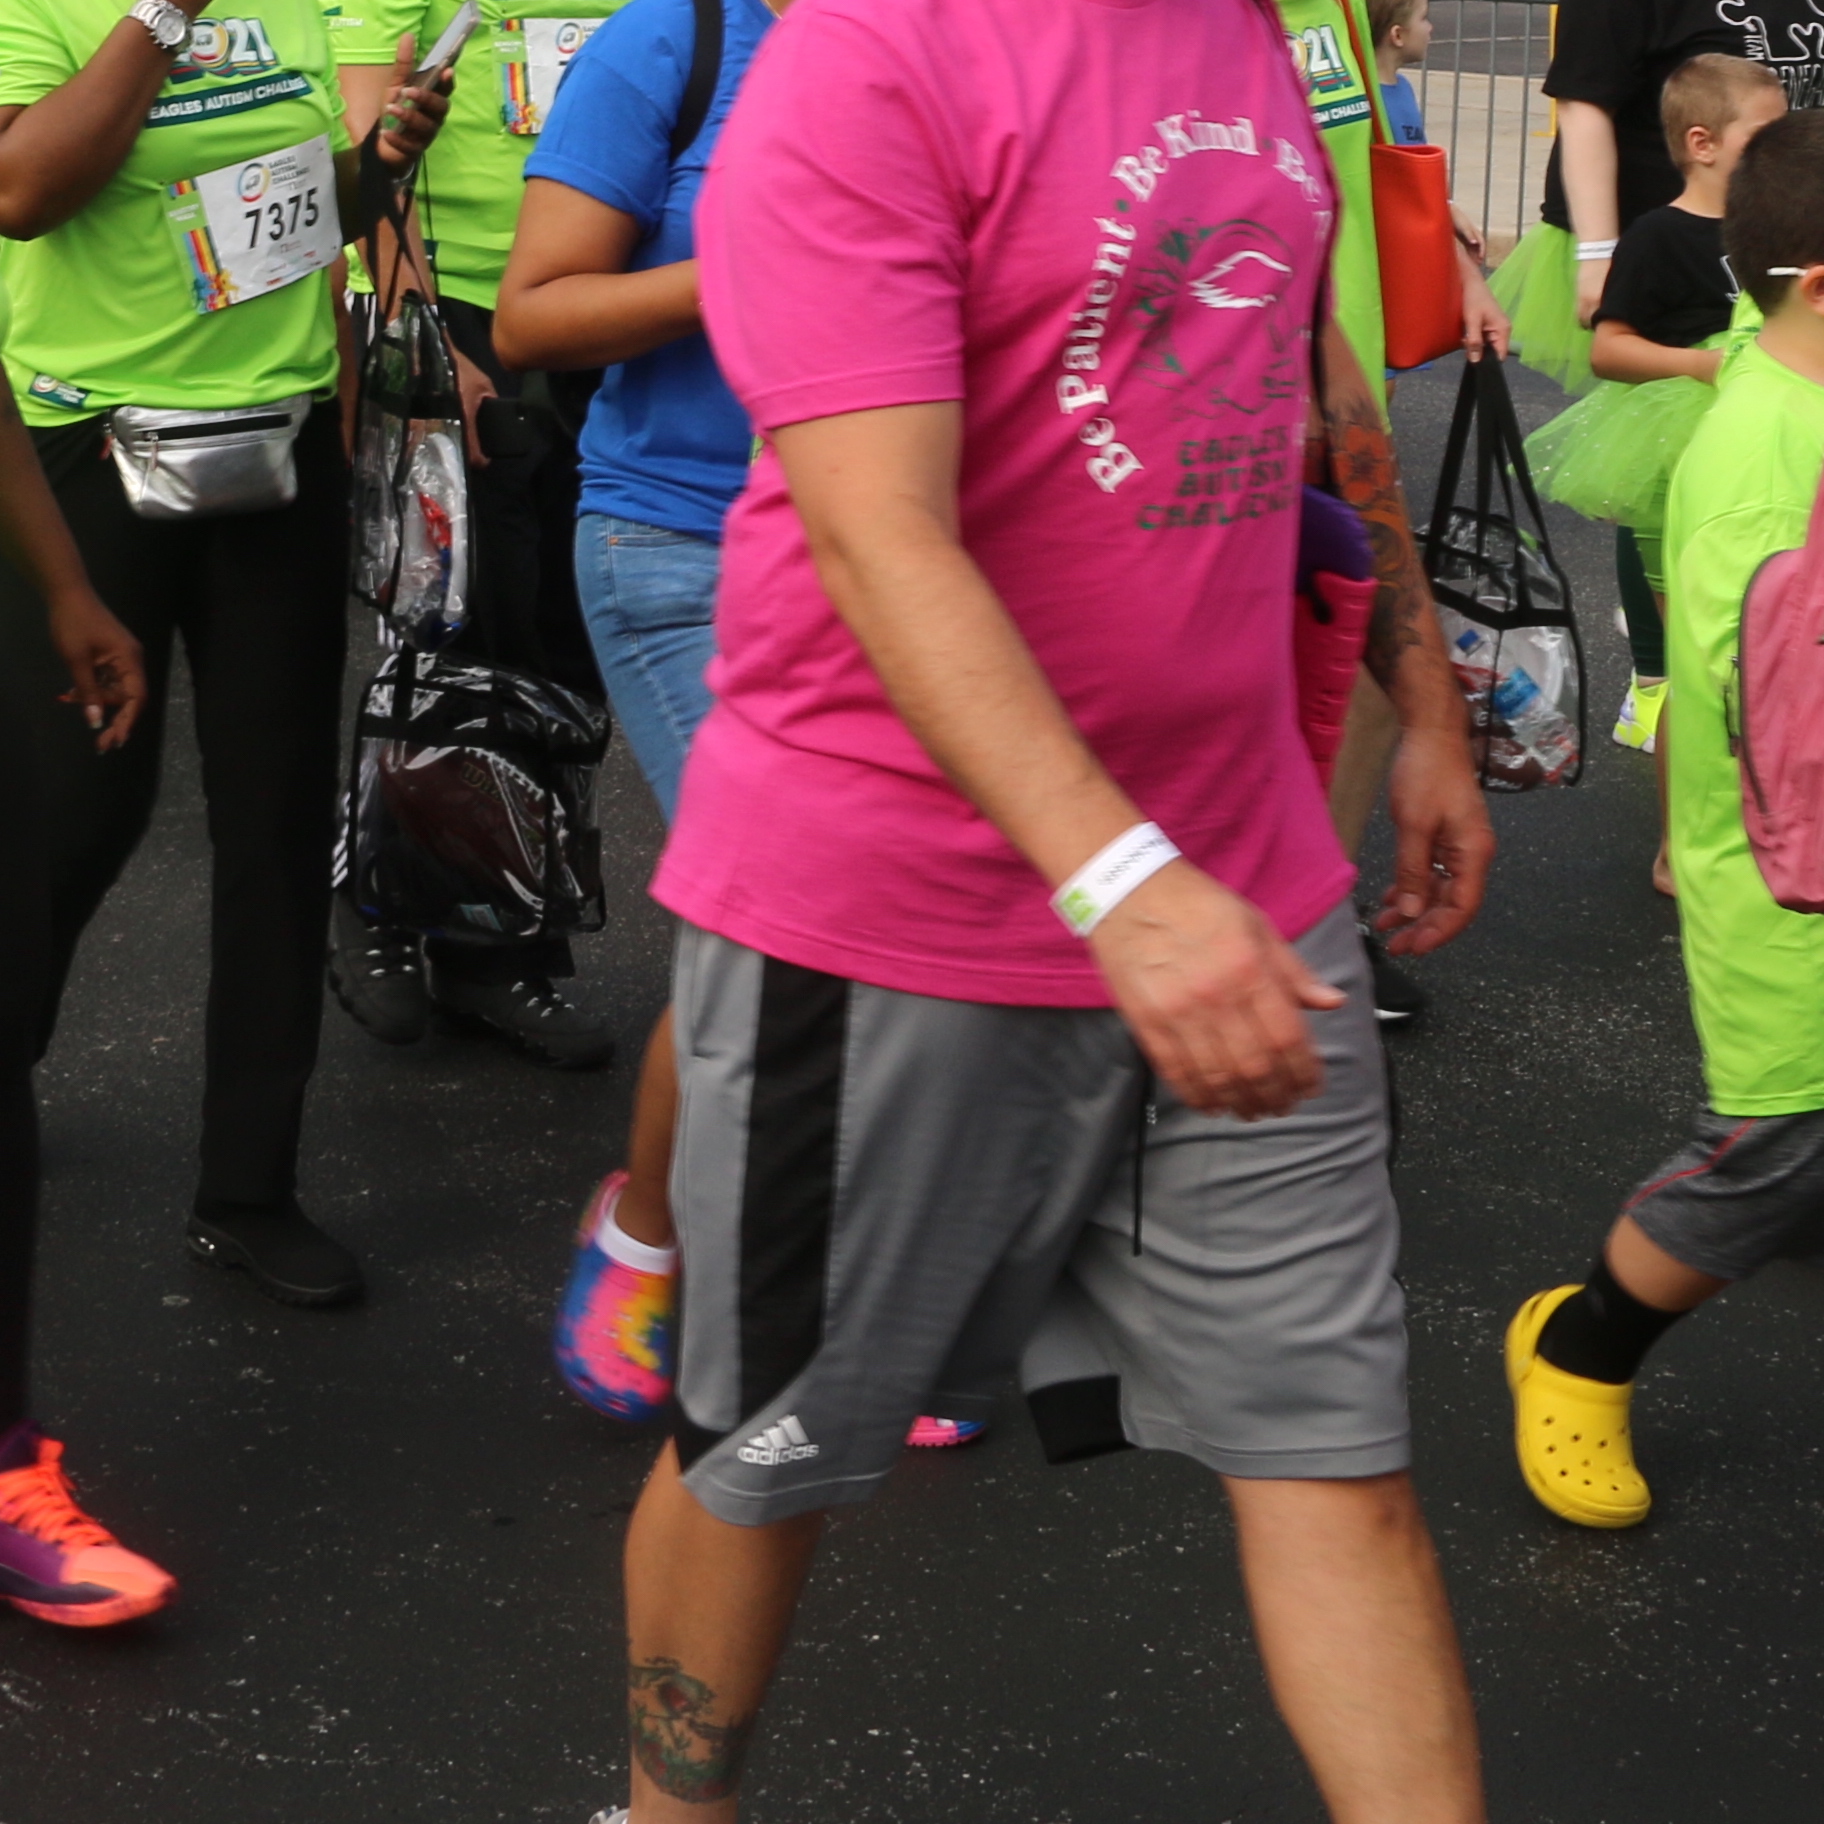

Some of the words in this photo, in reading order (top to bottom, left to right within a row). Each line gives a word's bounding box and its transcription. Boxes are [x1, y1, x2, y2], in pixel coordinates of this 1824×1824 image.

[148, 96, 203, 120] EAGLES
[204, 87, 254, 111] AUTISM
[1152, 110, 1261, 159] Kind
[1110, 146, 1170, 203] Be
[245, 186, 320, 250] 7375
[1056, 217, 1137, 415] Patient
[1085, 417, 1145, 494] Be
[737, 1444, 819, 1466] adidas
